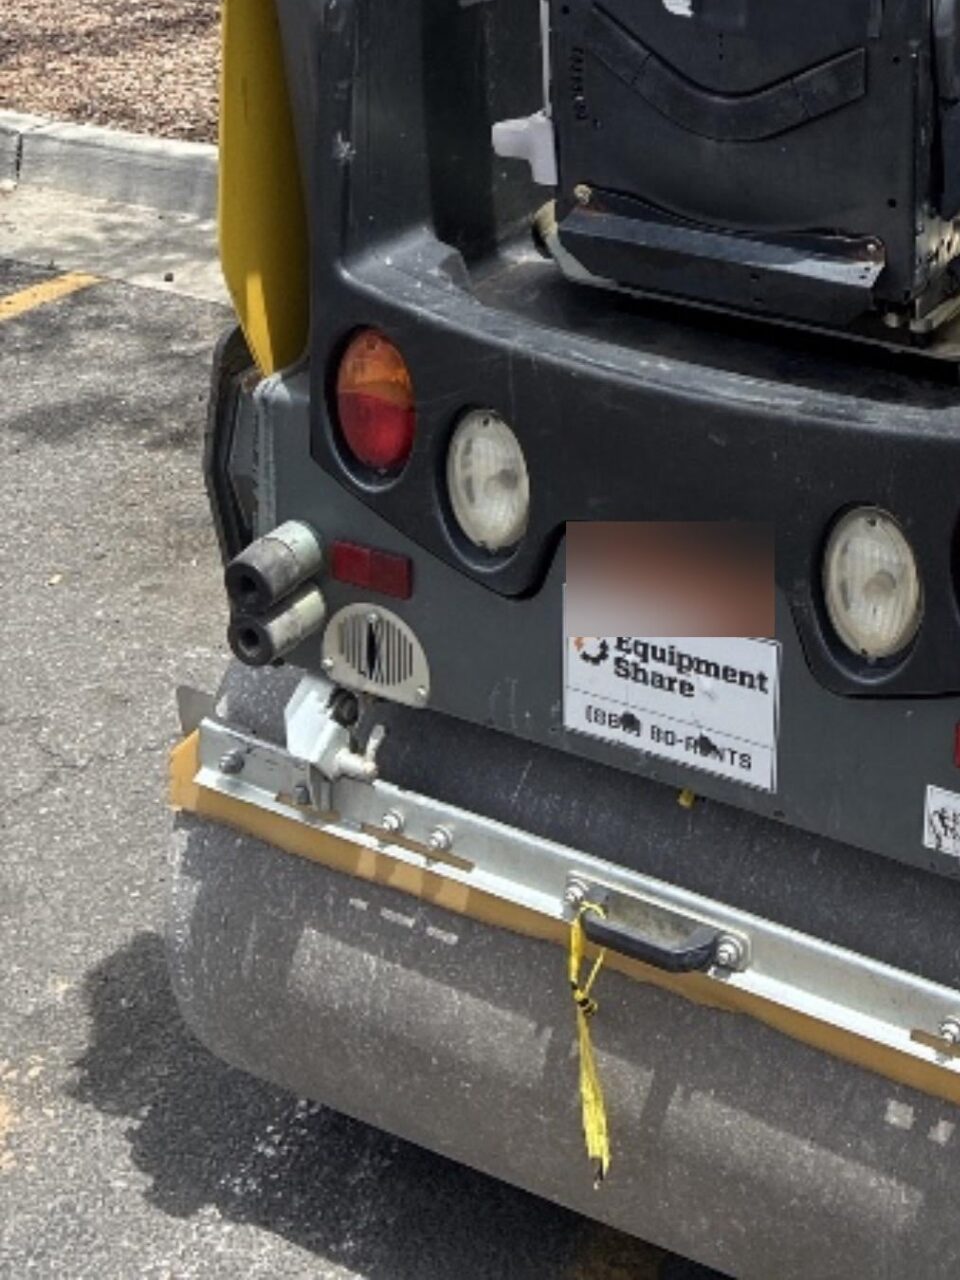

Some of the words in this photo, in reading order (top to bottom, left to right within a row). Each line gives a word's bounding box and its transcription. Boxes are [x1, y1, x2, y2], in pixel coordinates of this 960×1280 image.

[613, 656, 695, 699] Share
[614, 636, 769, 695] Equipment
[585, 704, 642, 738] (88)
[650, 724, 753, 771] 80-RNTS
